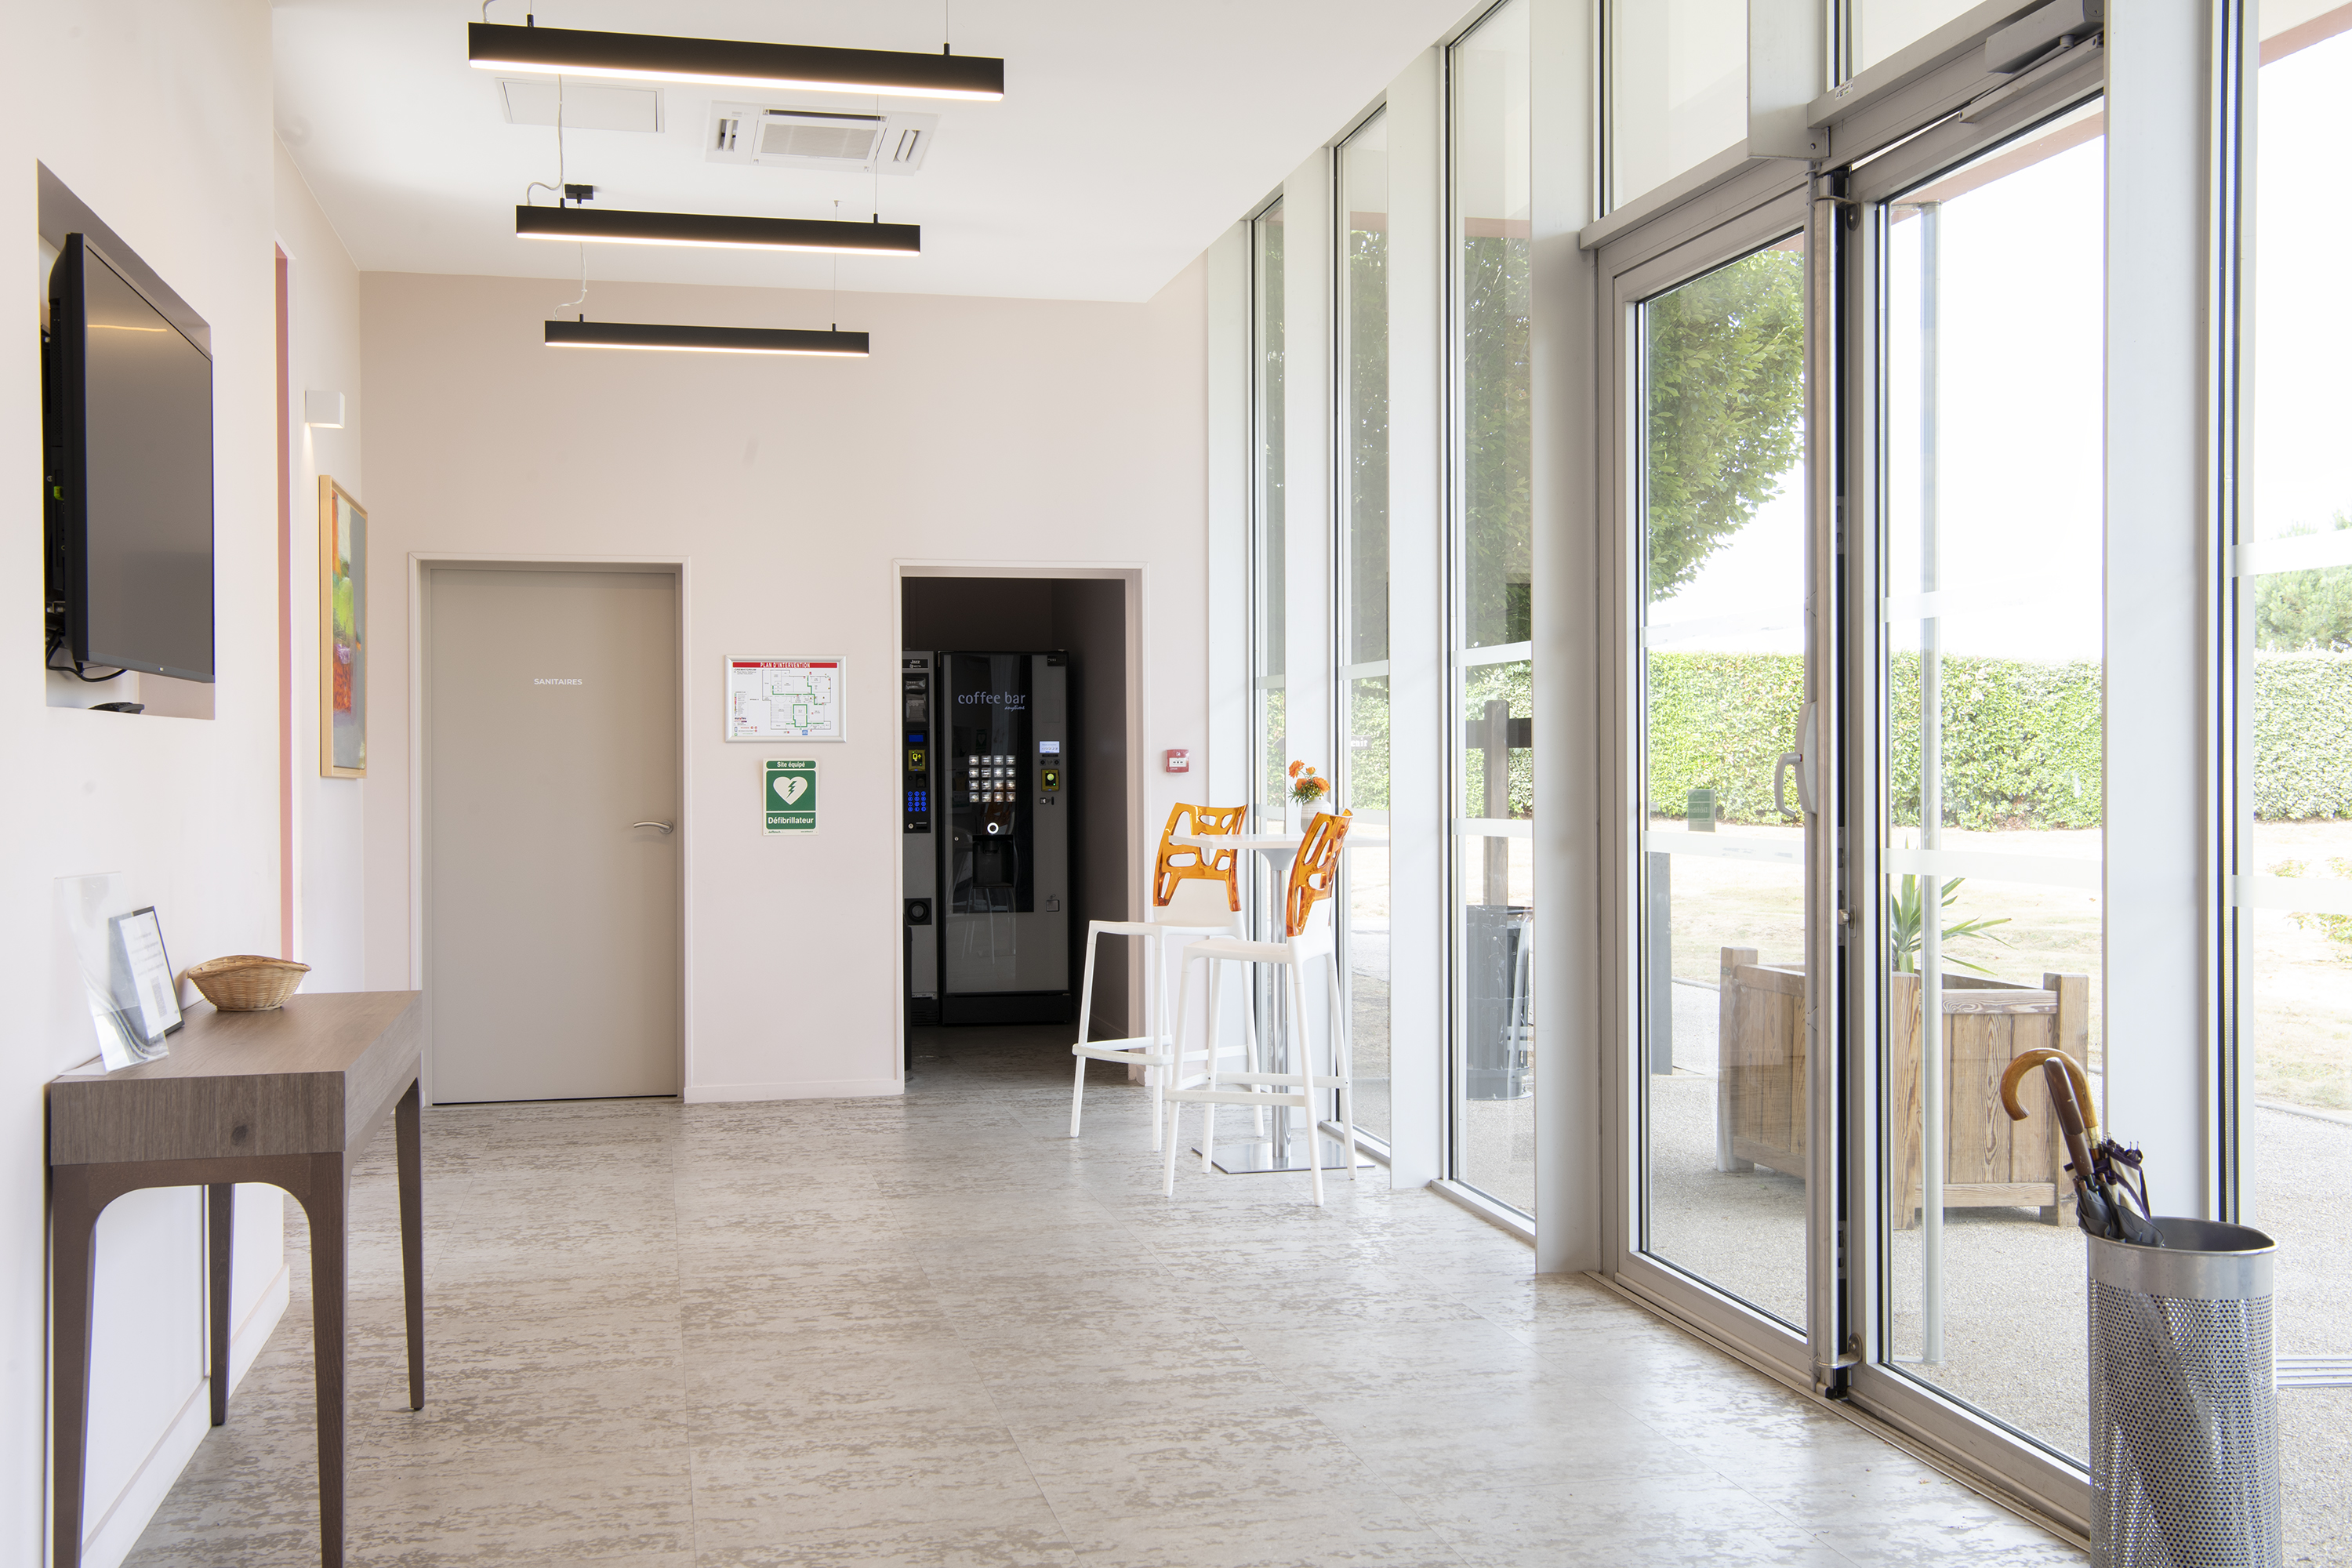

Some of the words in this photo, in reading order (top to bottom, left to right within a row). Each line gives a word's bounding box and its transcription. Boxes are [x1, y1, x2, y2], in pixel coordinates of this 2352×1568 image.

[957, 691, 1001, 705] coffee
[1004, 691, 1025, 705] bar
[1351, 737, 1368, 747] enir
